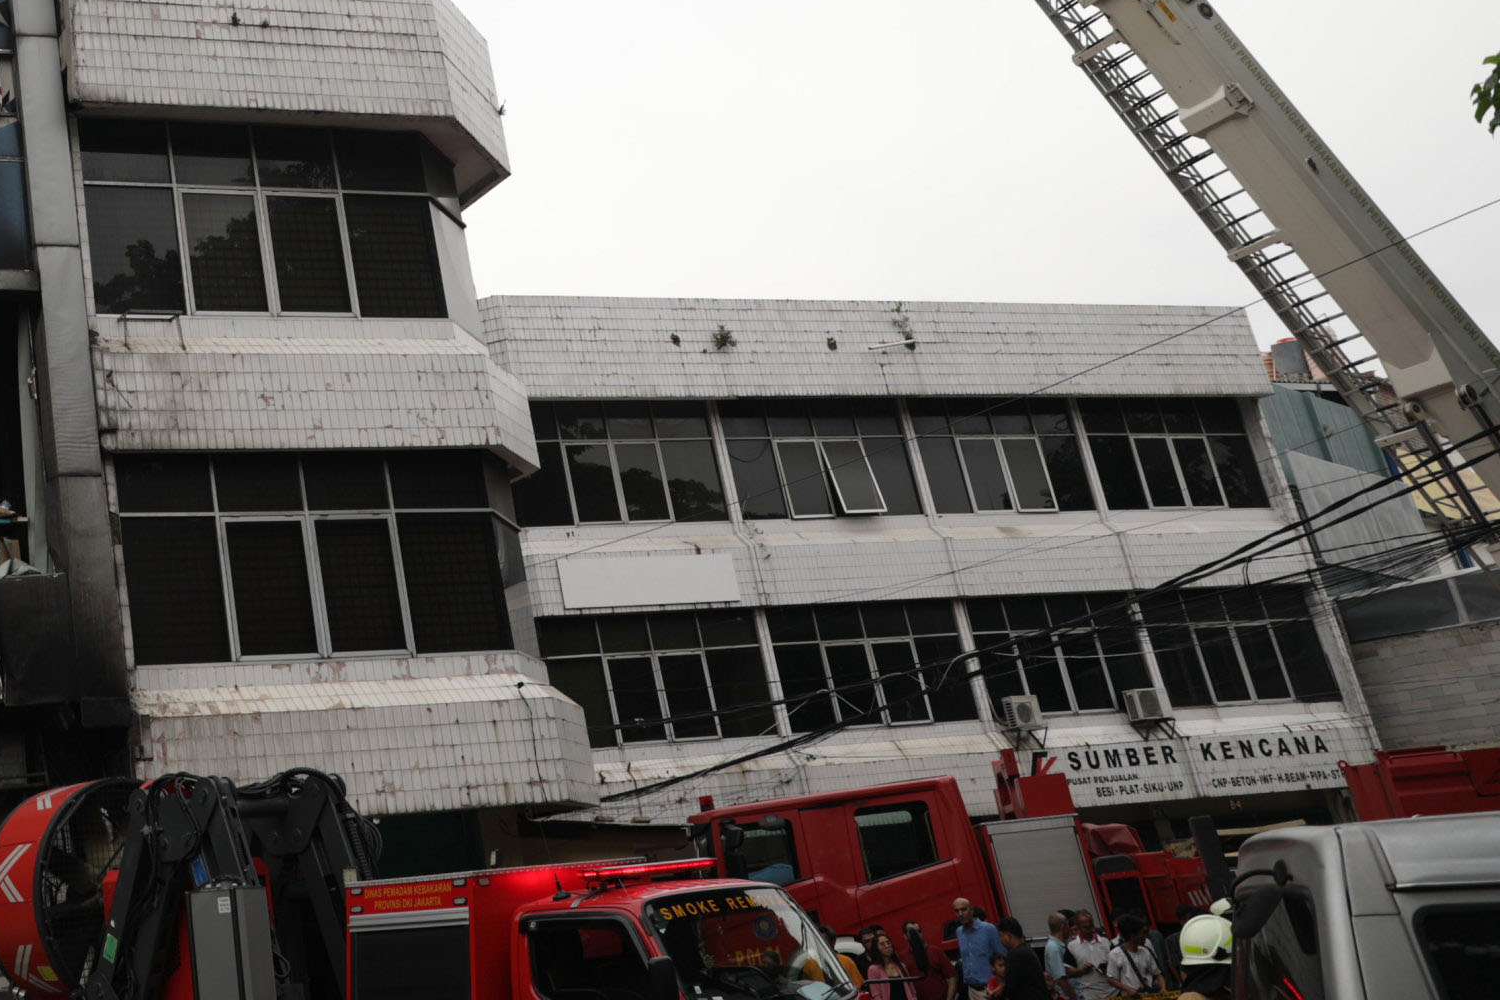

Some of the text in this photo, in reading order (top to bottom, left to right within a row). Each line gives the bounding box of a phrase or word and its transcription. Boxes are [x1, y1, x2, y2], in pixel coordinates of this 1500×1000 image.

[1213, 22, 1238, 50] DINAS
[1235, 49, 1307, 133] PENANGGULANGAN
[1304, 131, 1352, 187] KEBAKARAN
[1349, 185, 1369, 208] DAN
[1366, 206, 1429, 279] PENYELAMATAN
[1426, 277, 1466, 324] PROVINSI
[1463, 322, 1480, 341] DKI
[1068, 745, 1177, 770] SUMBER
[1200, 735, 1328, 761] KENCANA
[1067, 773, 1139, 786] PUSAT PENJUALAN
[364, 881, 452, 898] DINAS PEMADAM KEBAKARAN
[374, 895, 442, 911] PROVINSI DKI JAKARTA
[660, 898, 721, 920] SMOKE
